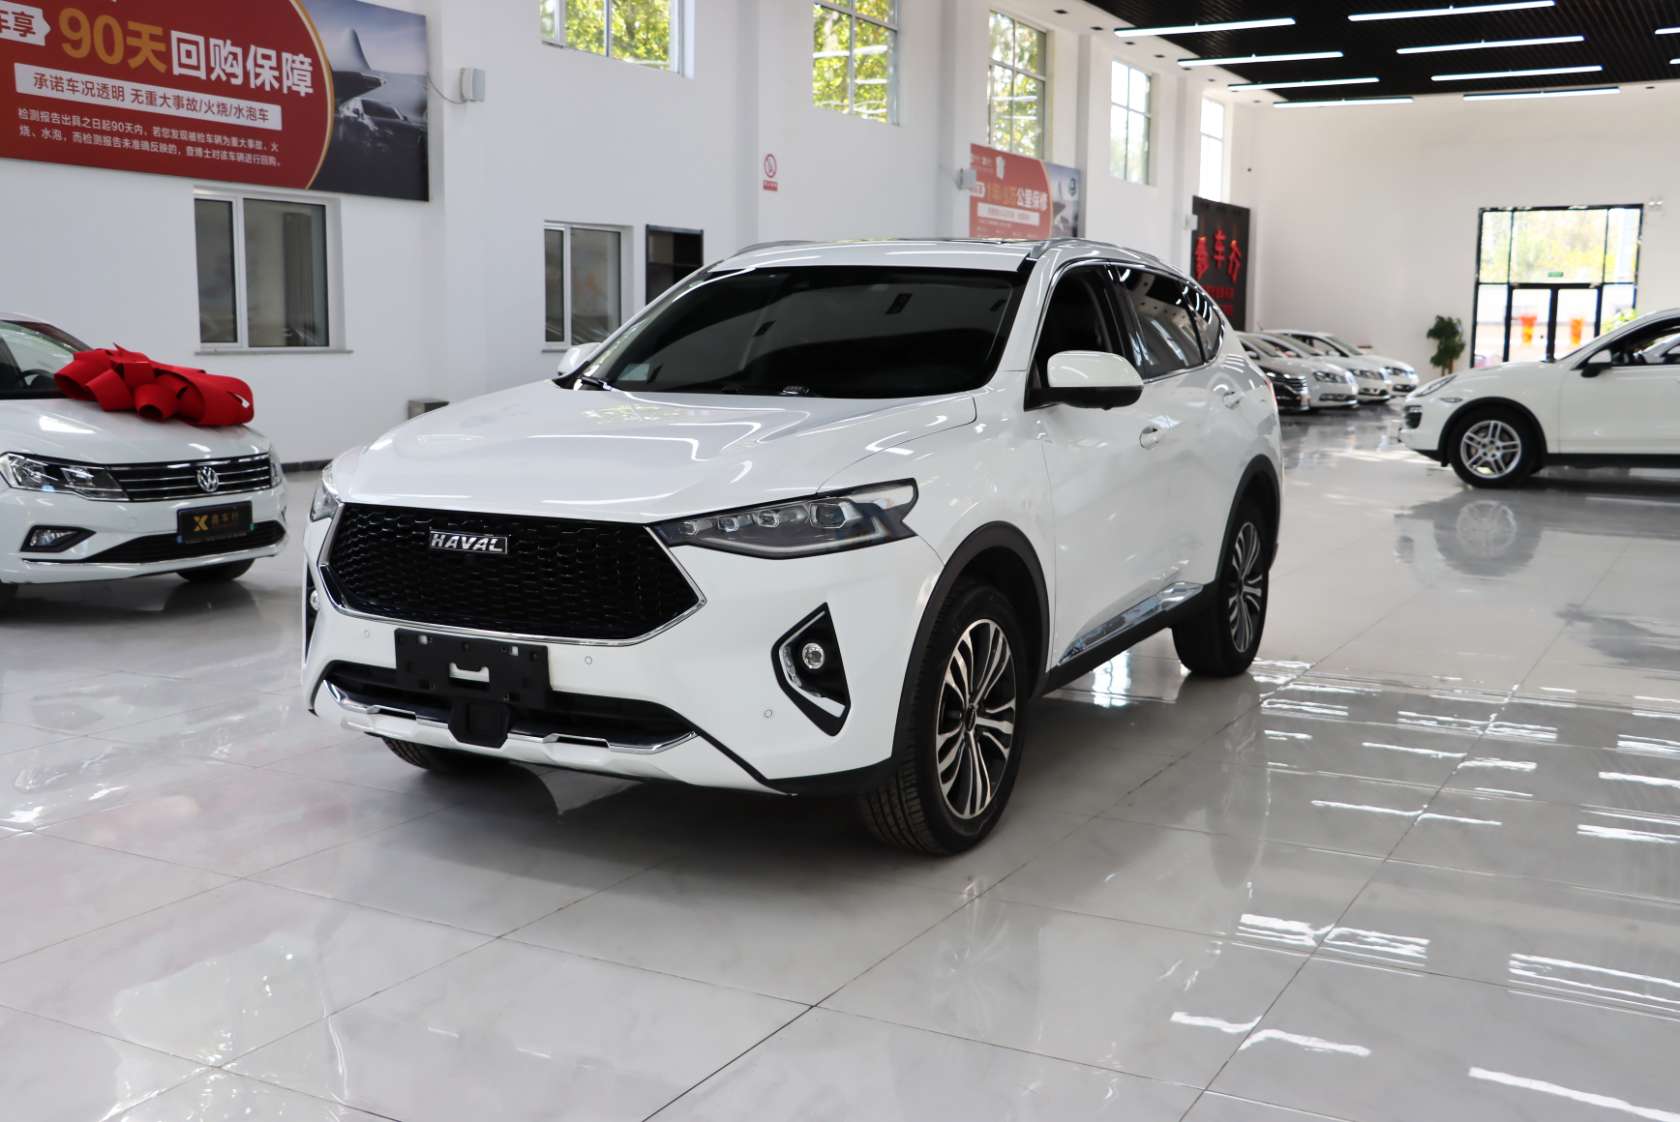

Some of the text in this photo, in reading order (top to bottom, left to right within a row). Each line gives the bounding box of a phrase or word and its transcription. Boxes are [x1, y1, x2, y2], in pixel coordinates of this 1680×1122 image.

[59, 7, 313, 97] 90天回购保障
[34, 72, 125, 102] 承诺车况透明
[431, 533, 503, 552] HAVAL
